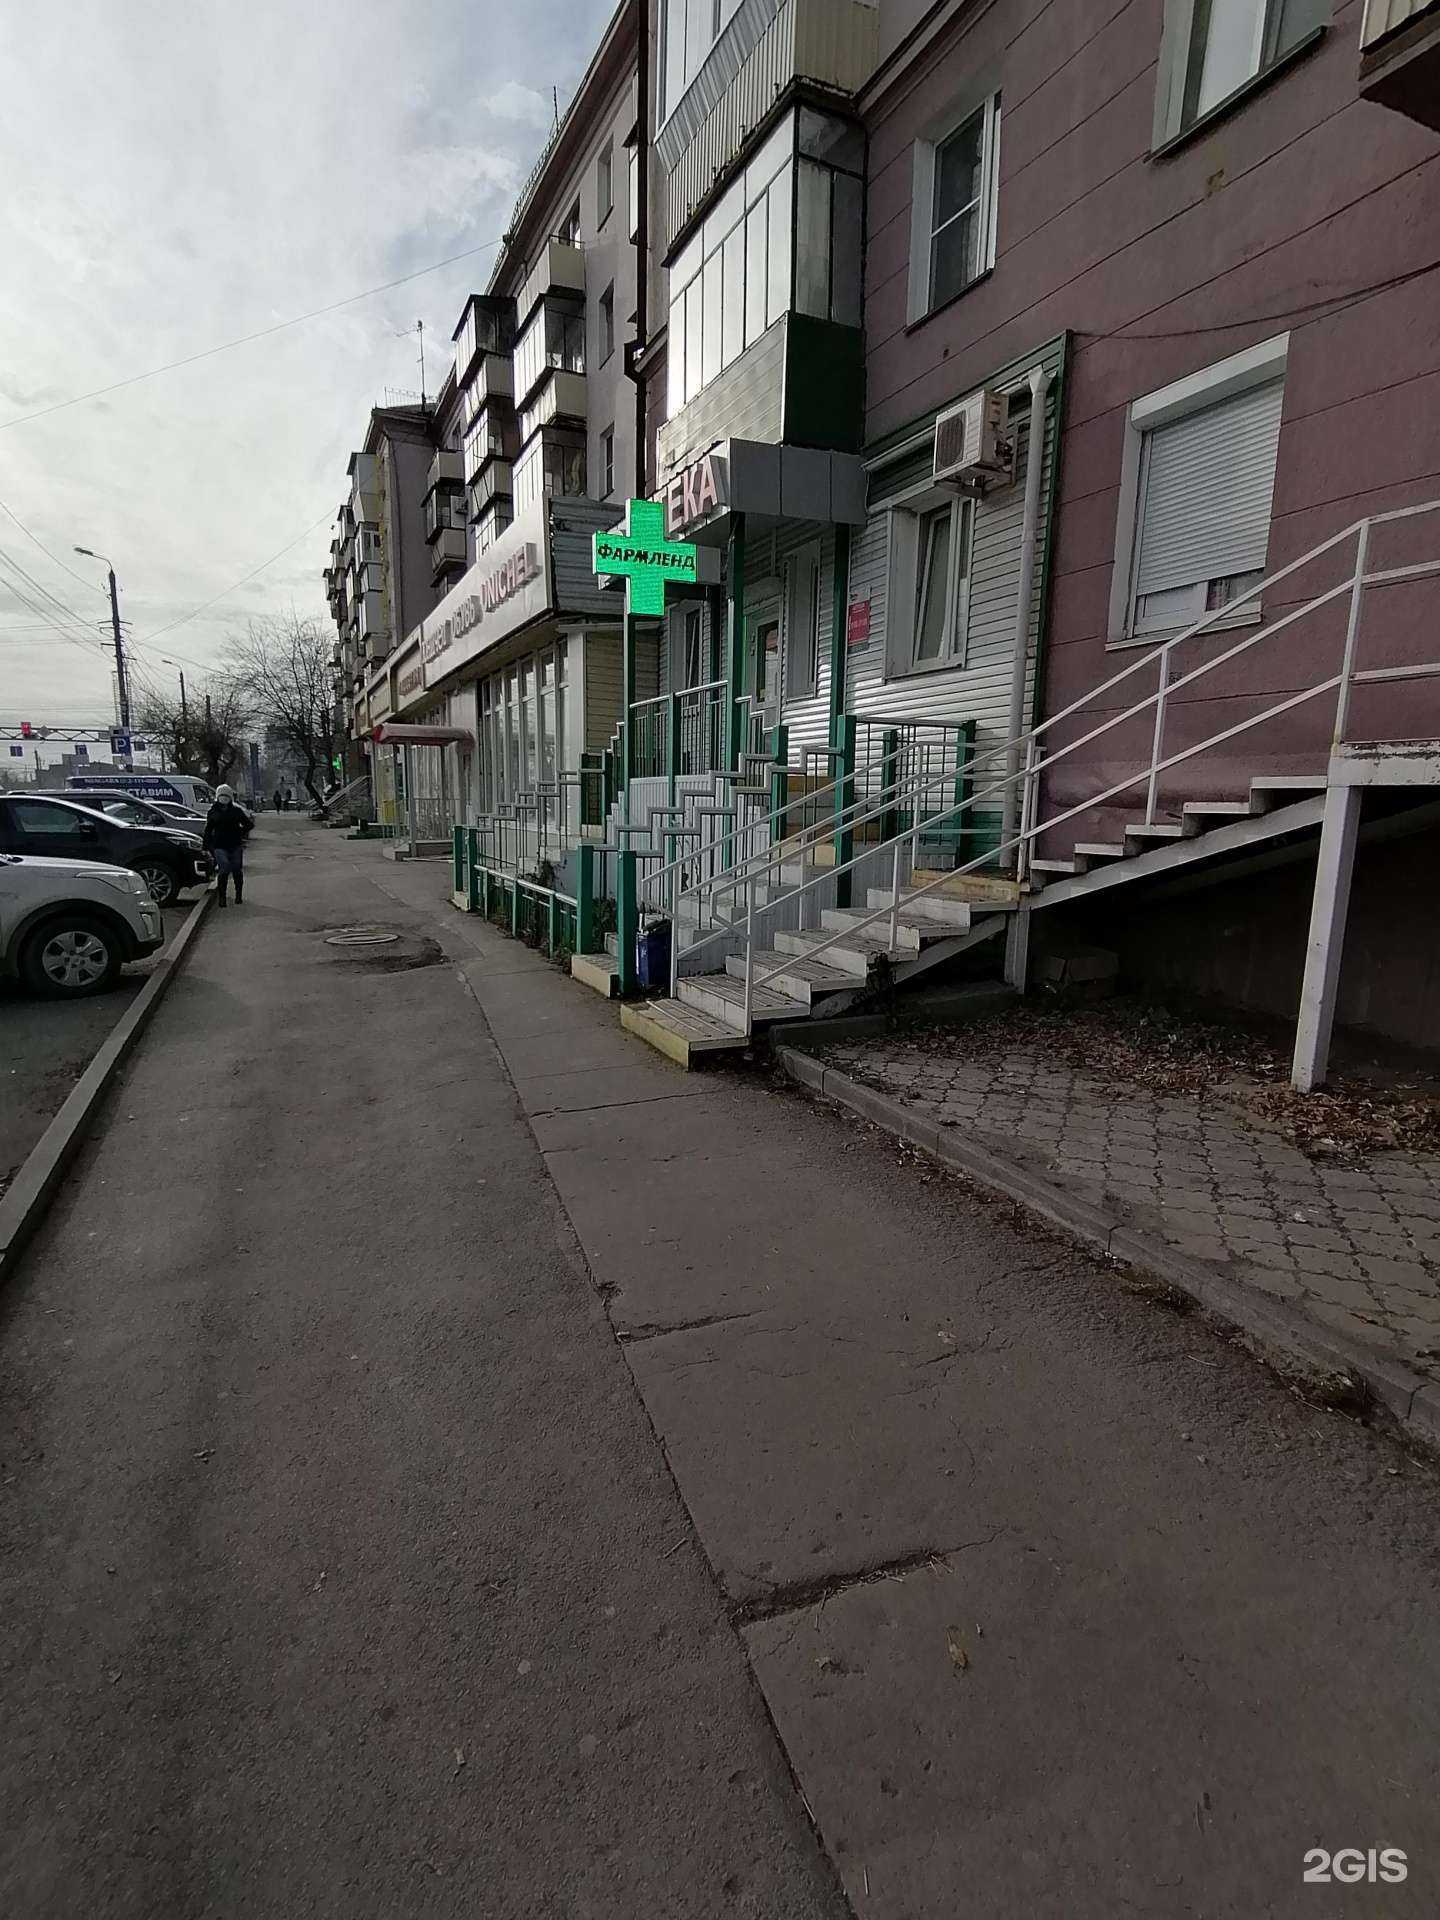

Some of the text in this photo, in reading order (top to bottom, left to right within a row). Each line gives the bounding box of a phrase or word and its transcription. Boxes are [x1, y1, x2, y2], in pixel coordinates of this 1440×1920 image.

[597, 543, 696, 571] ФАРМЛЕНД
[481, 543, 537, 611] UNICHEL
[115, 738, 127, 753] P
